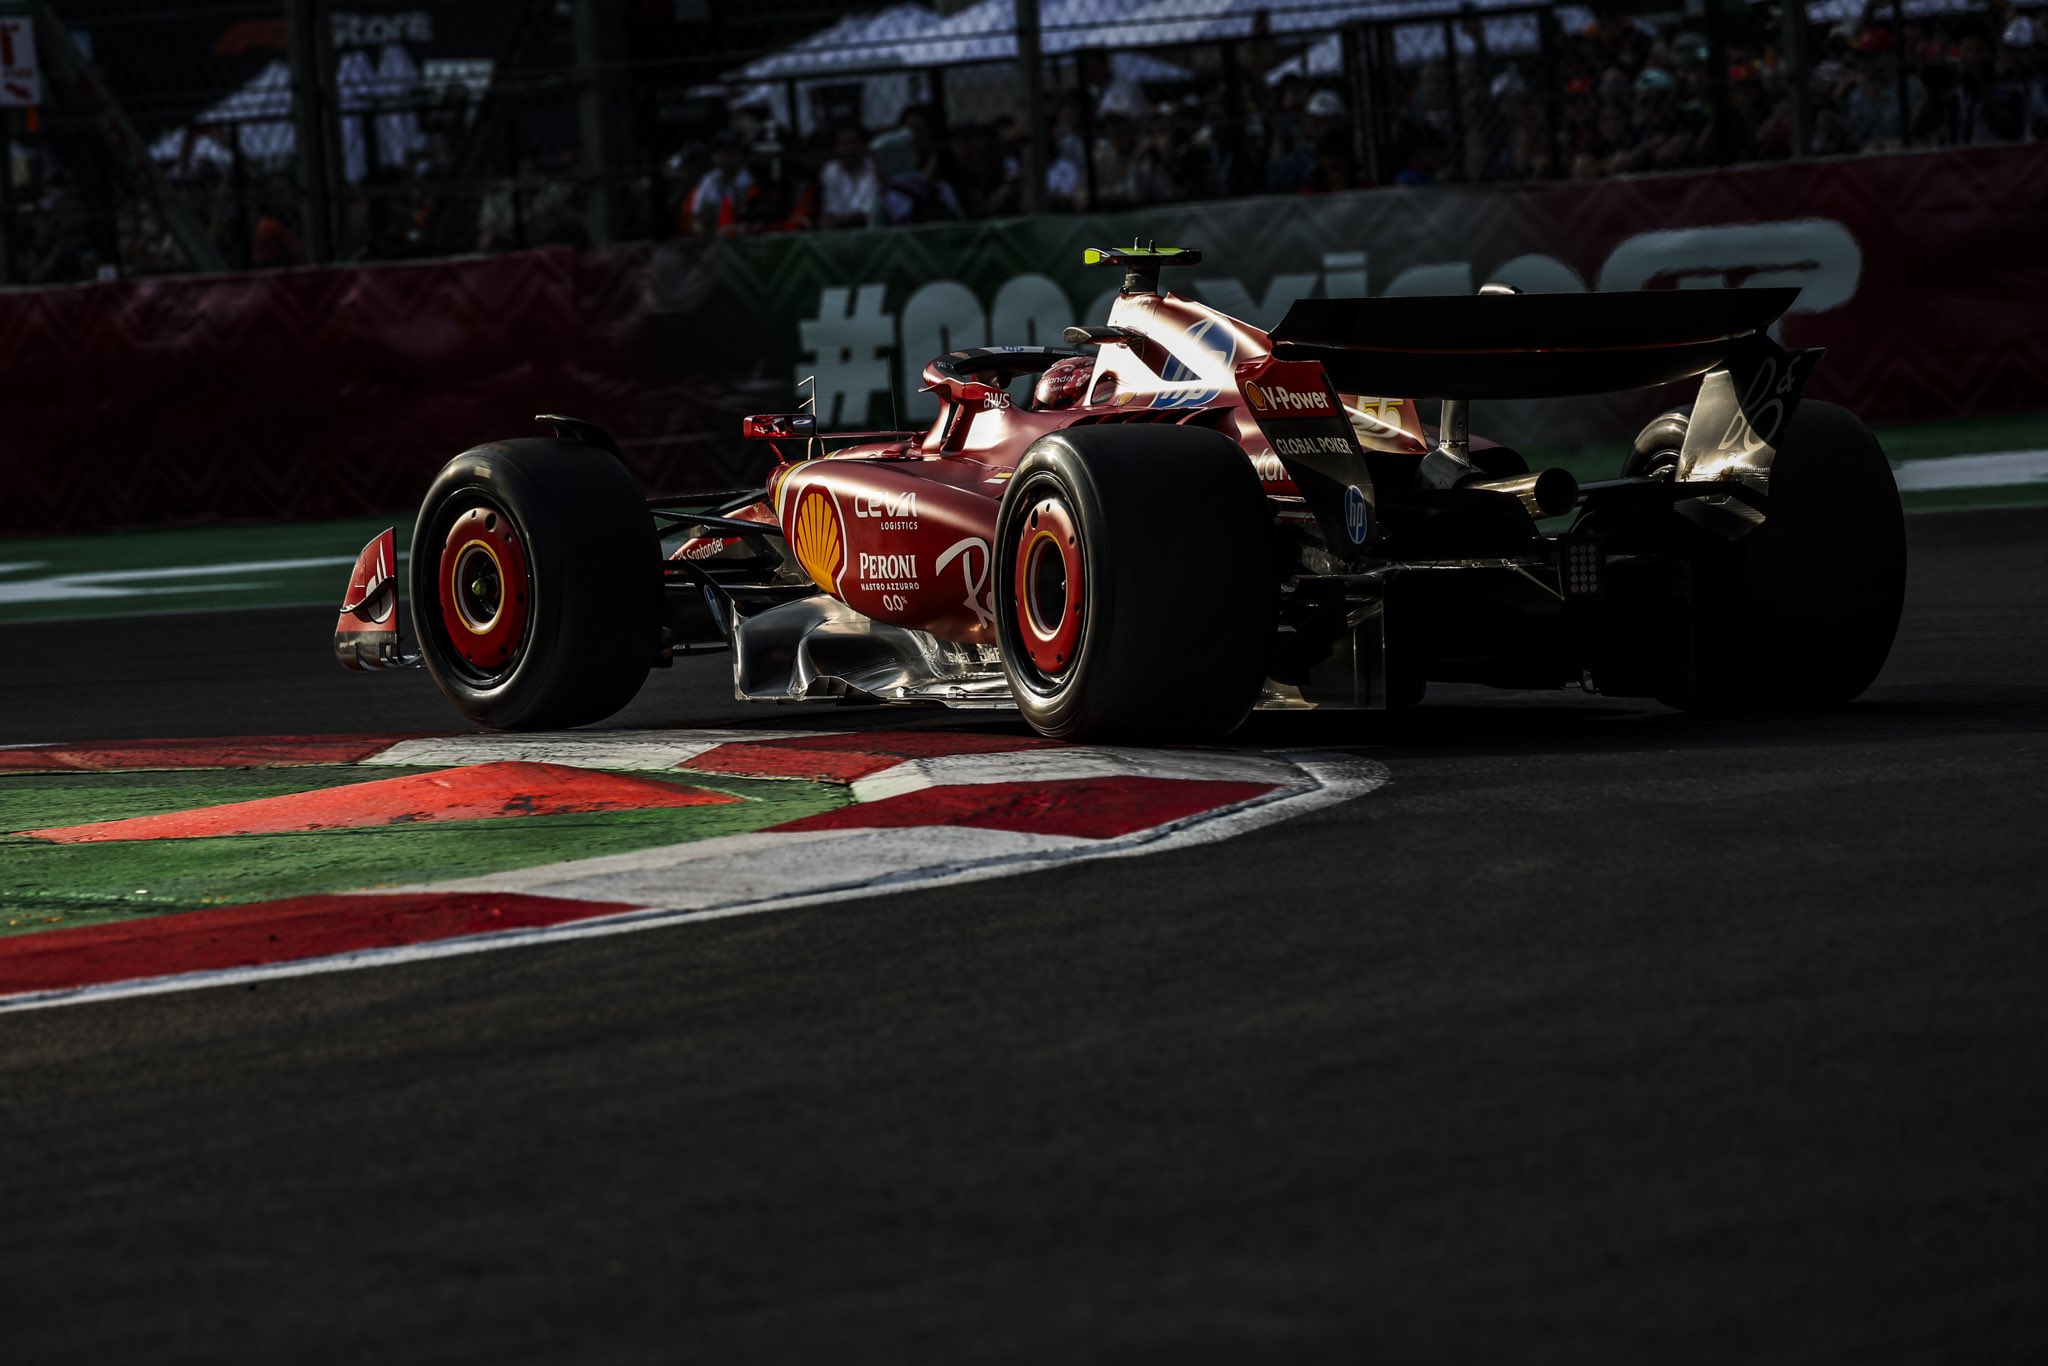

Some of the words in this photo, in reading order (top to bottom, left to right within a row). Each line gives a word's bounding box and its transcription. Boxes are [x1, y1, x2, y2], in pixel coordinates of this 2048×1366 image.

[1260, 387, 1330, 410] V-Power
[1276, 437, 1321, 455] GLOBAL
[1317, 437, 1354, 455] POKER
[880, 521, 918, 531] LOGISTICS
[1348, 486, 1365, 544] hp
[687, 538, 724, 560] Santander
[859, 552, 918, 580] PERONI
[861, 583, 885, 591] NASTRO
[886, 582, 920, 591] AZZURRO
